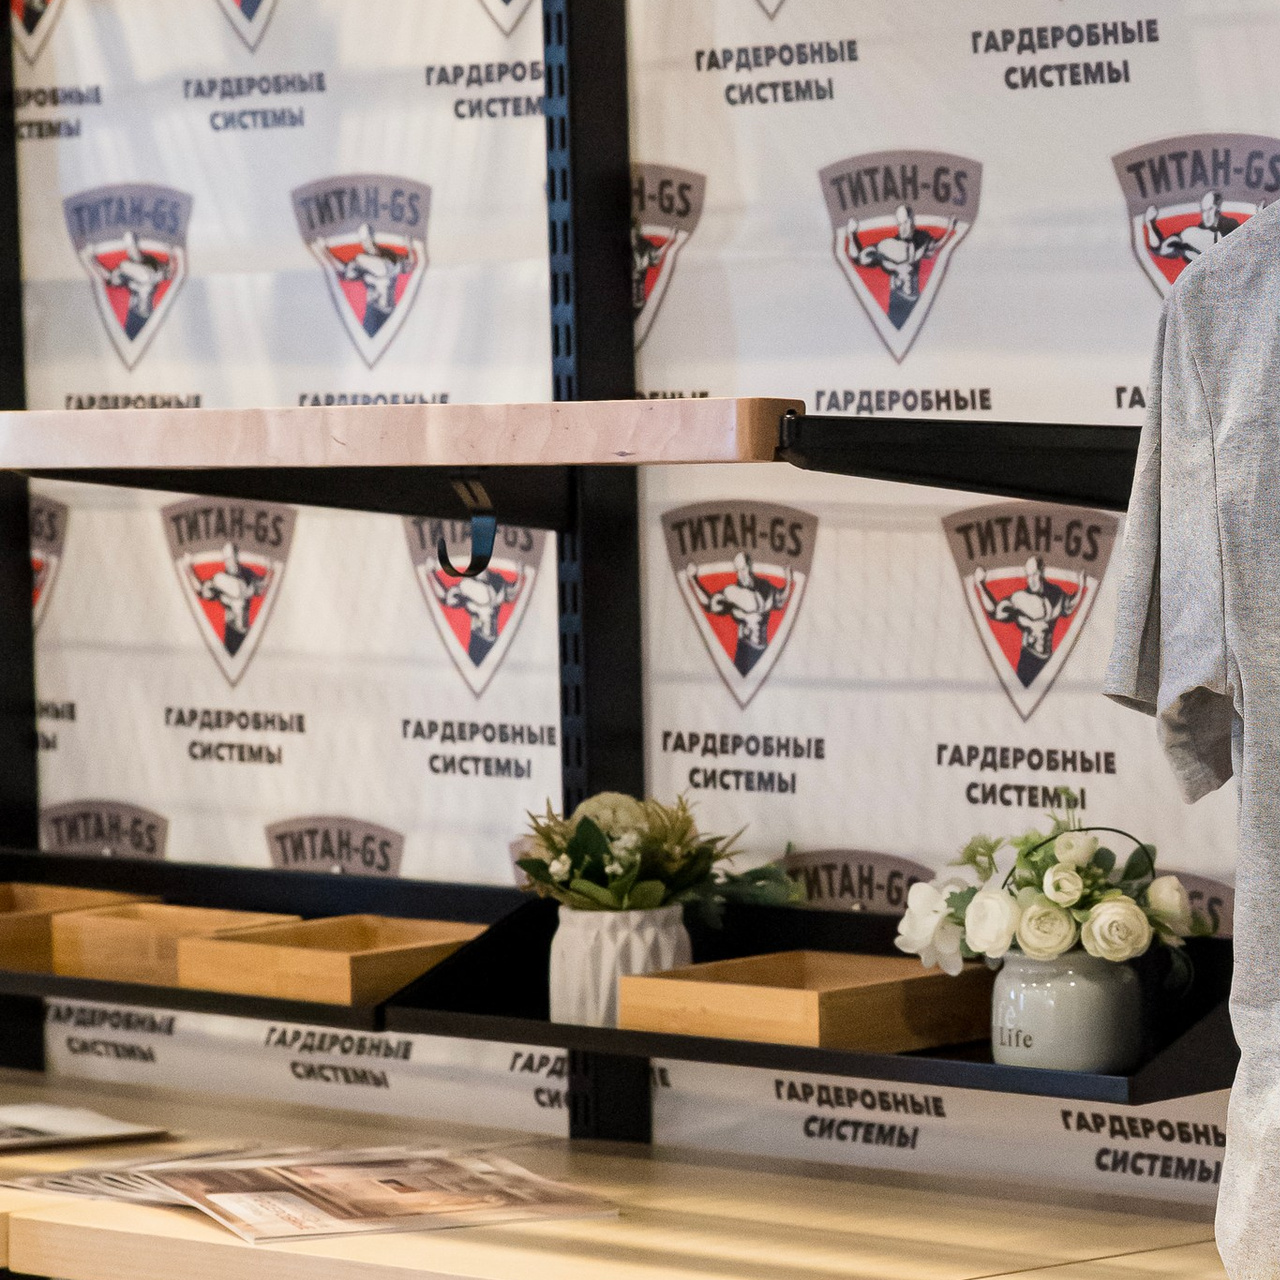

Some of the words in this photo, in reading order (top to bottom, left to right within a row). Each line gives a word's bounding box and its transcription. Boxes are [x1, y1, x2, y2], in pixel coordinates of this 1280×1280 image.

[972, 19, 1160, 54] ГАРДЕРОБНЫЕ
[695, 40, 859, 72] ГАРДЕРОБНЫЕ
[184, 72, 326, 101] ГАРДЕРОБНЫЕ
[1004, 60, 1130, 91] СИСТЕМЫ
[725, 78, 834, 106] СИСТЕМЫ
[209, 107, 304, 132] СИСТЕМЫ
[830, 165, 967, 211] ТИТАН-GS
[815, 388, 992, 414] ГАРДЕРОБНЫЕ
[671, 513, 802, 557] ТИТАН-GS
[955, 519, 1101, 561] ТИТАН-GS
[165, 706, 306, 733] ГАРДЕРОБНЫЕ
[402, 719, 556, 746] ГАРДЕРОБНЫЕ
[188, 740, 282, 764] СИСТЕМЫ
[662, 730, 825, 760] ГАРДЕРОБНЫЕ
[936, 743, 1117, 776] ГАРДЕРОБНЫЕ
[429, 754, 532, 779] СИСТЕМЫ
[689, 767, 797, 794] СИСТЕМЫ
[966, 781, 1087, 810] СИСТЕМЫ
[275, 827, 392, 871] ТИТАН-GS
[264, 1026, 414, 1061] ГАРДЕРОБНЫЕ
[290, 1061, 390, 1089] СИСТЕМЫ
[774, 1078, 946, 1118] ГАРДЕРОБНЫЕ
[803, 1114, 919, 1150] СИСТЕМЫ
